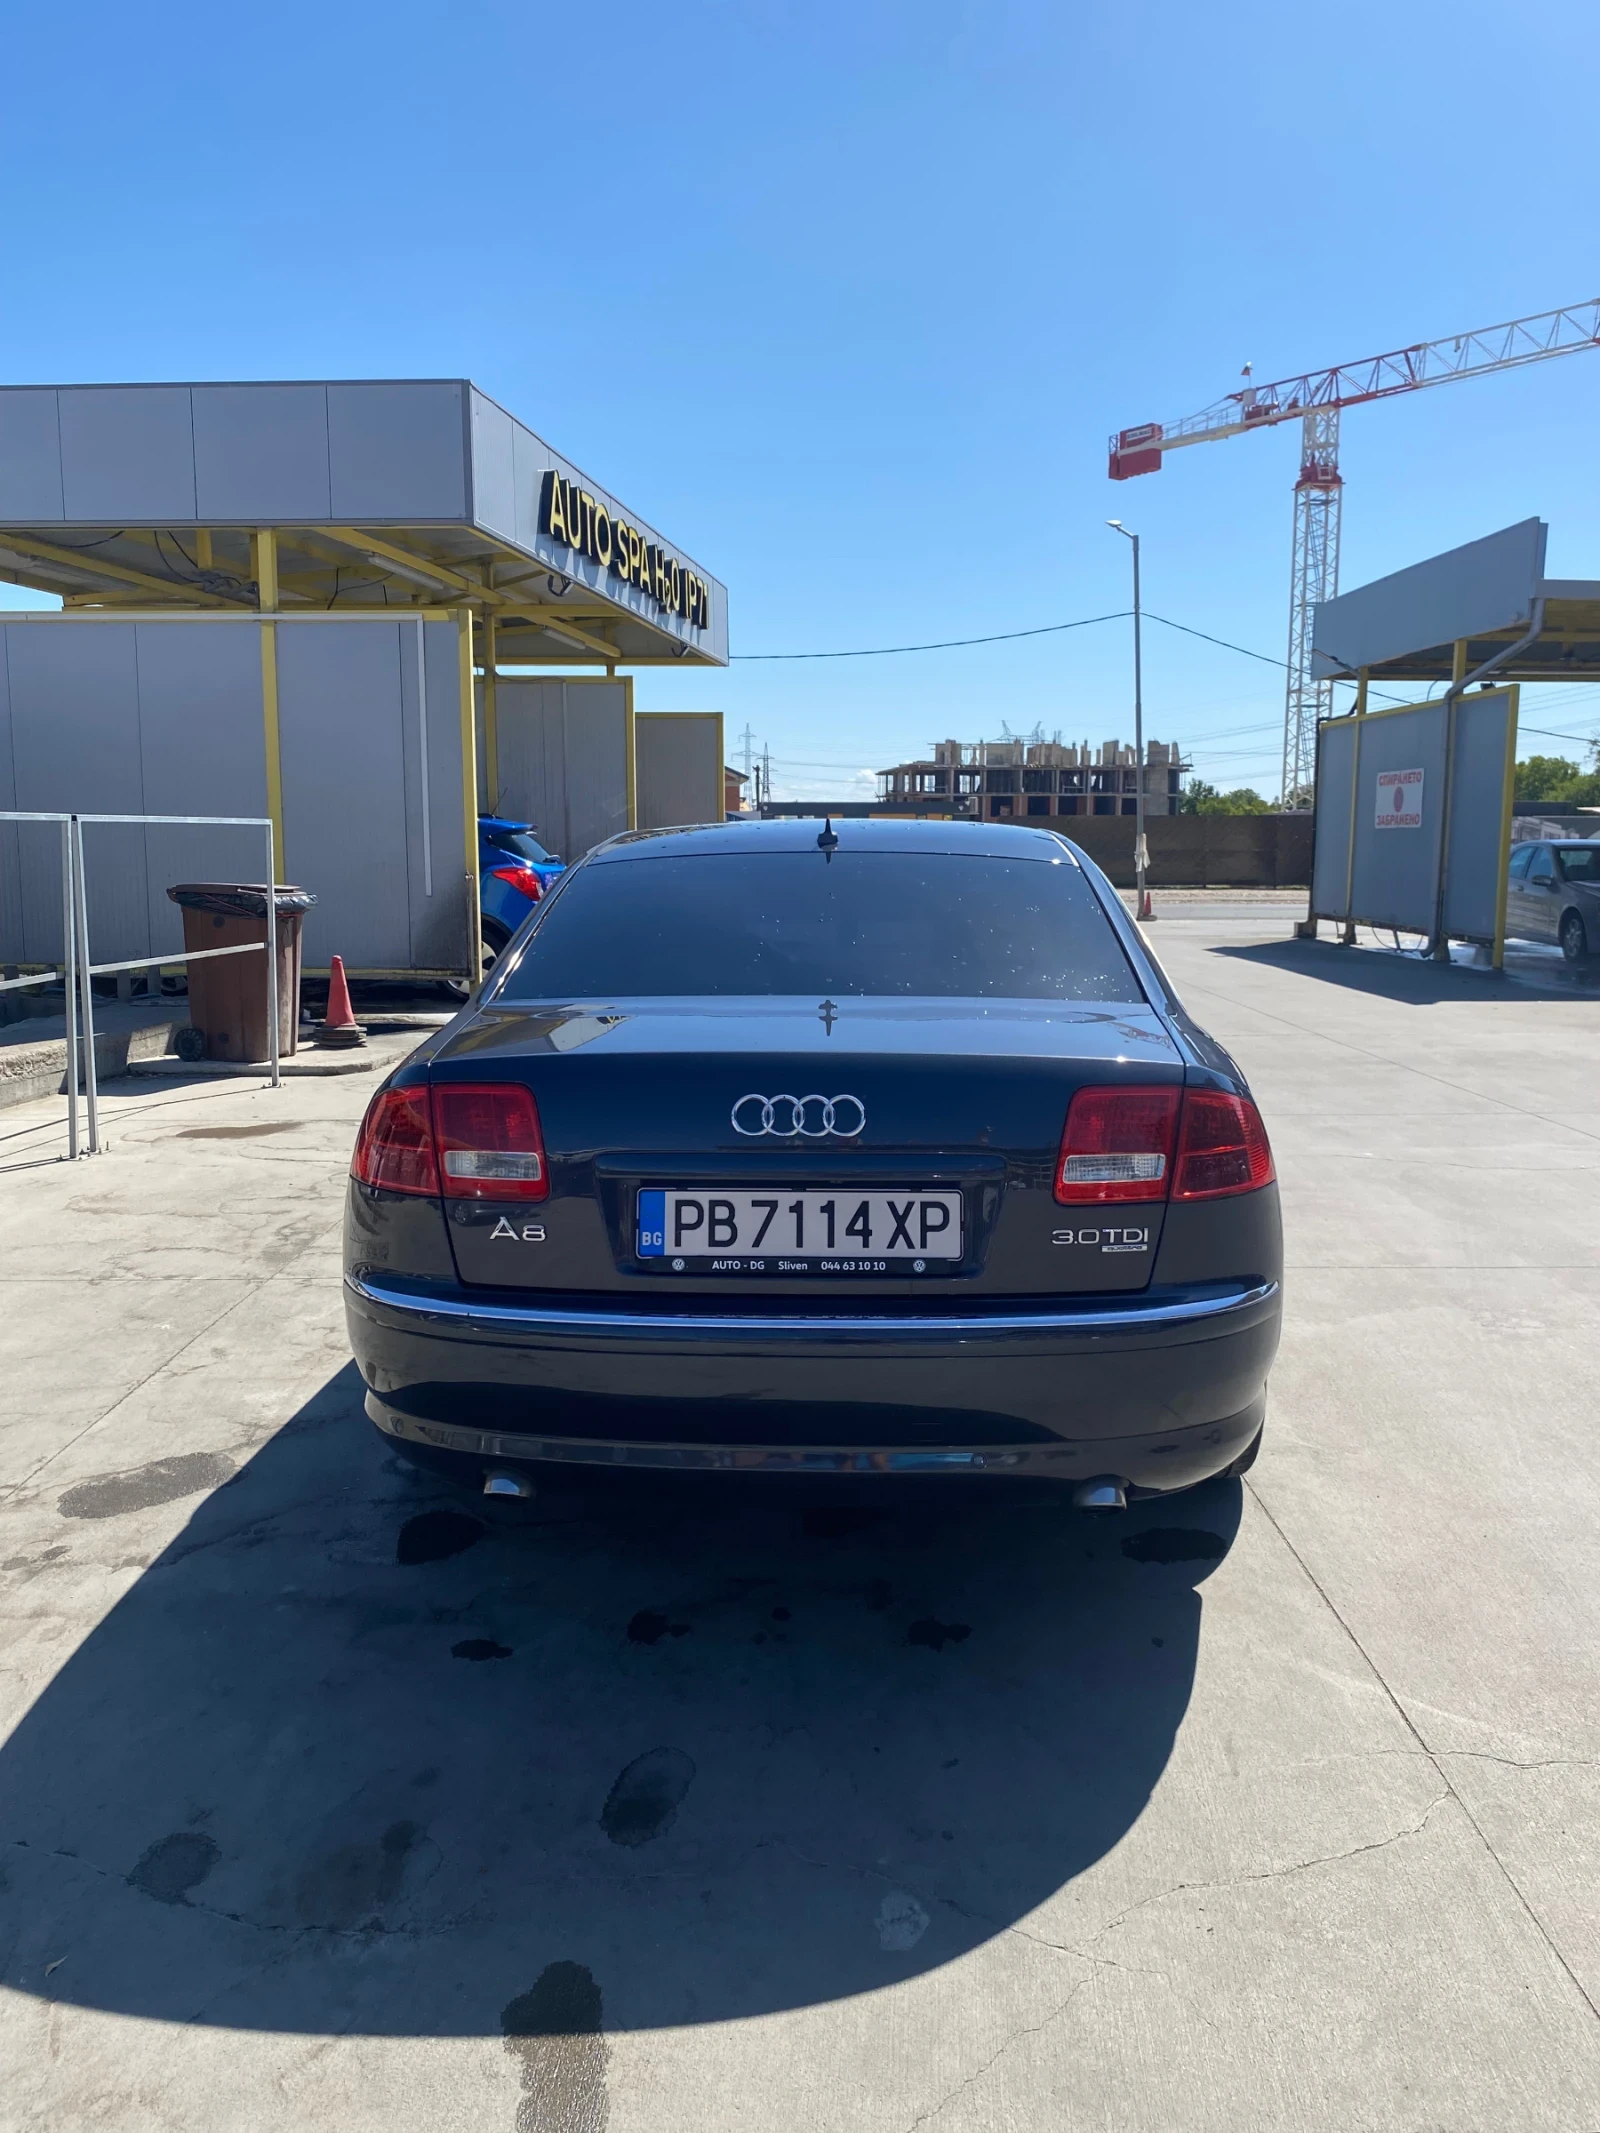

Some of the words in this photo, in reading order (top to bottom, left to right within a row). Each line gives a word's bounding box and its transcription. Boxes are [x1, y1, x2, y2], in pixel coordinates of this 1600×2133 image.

[544, 469, 612, 567] AUTO
[612, 518, 652, 595] SPA
[489, 1216, 546, 1242] A8
[750, 1199, 873, 1249] 7114
[641, 1231, 663, 1246] BG
[711, 1260, 741, 1271] AUTO
[749, 1260, 765, 1271] DG
[777, 1260, 808, 1271] Sliven
[820, 1261, 841, 1271] 044
[842, 1261, 856, 1272] 63
[858, 1261, 872, 1272] 10
[873, 1261, 886, 1272] 10
